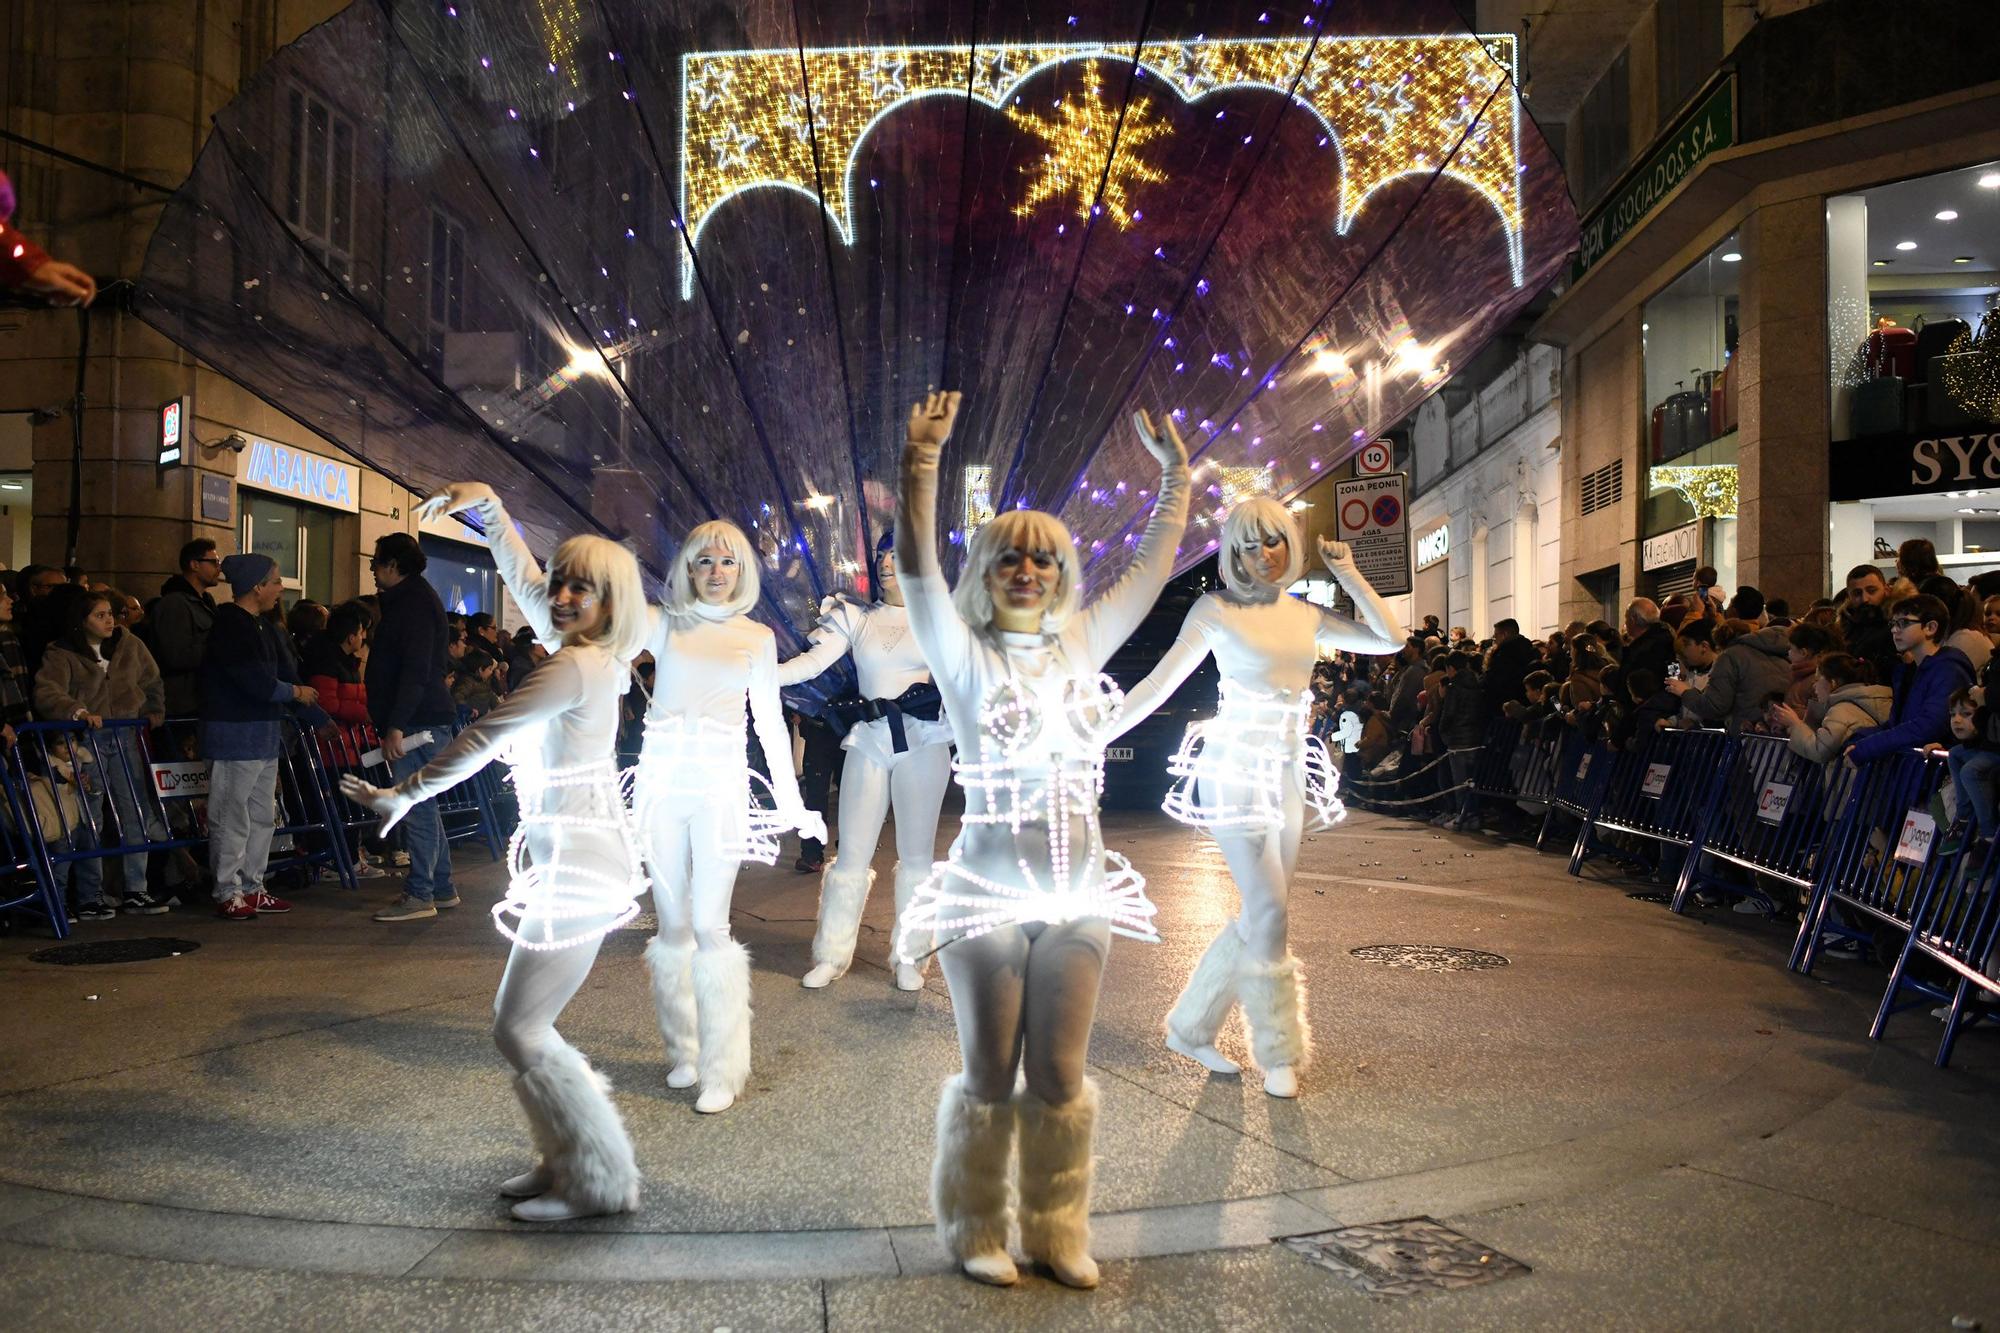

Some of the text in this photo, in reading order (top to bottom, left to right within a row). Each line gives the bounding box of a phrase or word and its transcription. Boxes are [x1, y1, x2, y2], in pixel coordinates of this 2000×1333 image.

[1367, 453, 1382, 463] 10
[256, 442, 350, 505] ABANCA
[1340, 480, 1400, 495] ZONA PEONIL
[1355, 537, 1388, 546] BICICLETAS
[1370, 548, 1402, 557] DESCARGA
